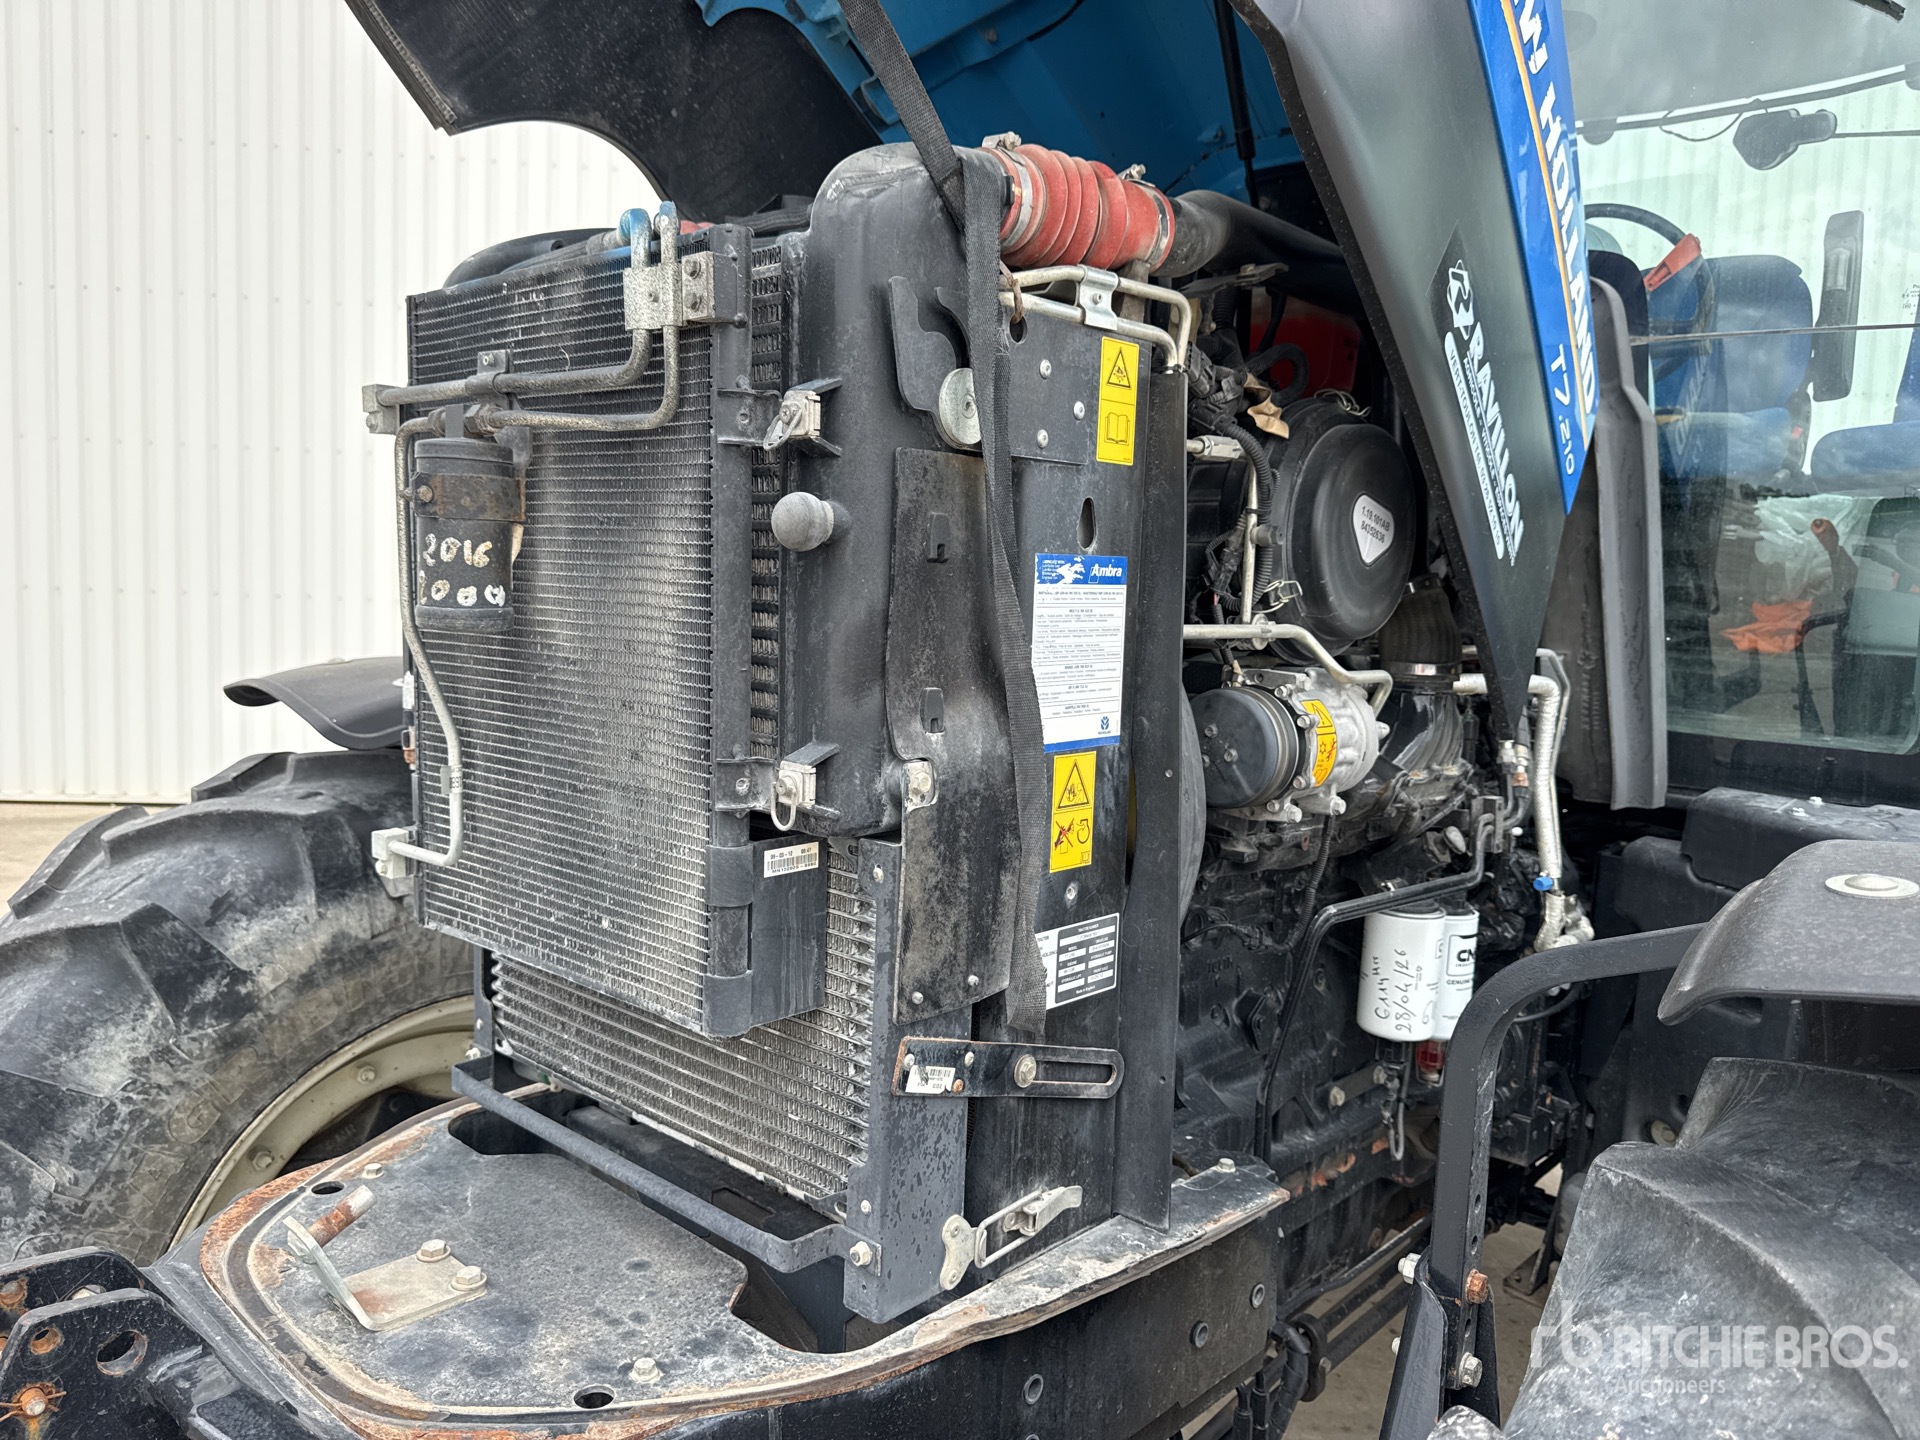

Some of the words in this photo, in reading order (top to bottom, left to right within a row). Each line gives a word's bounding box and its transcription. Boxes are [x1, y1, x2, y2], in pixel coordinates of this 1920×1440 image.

[1540, 80, 1596, 414] HOLLAND
[1469, 320, 1525, 556] RAVILLON
[422, 533, 494, 569] 2016
[1091, 563, 1123, 577] Ambra
